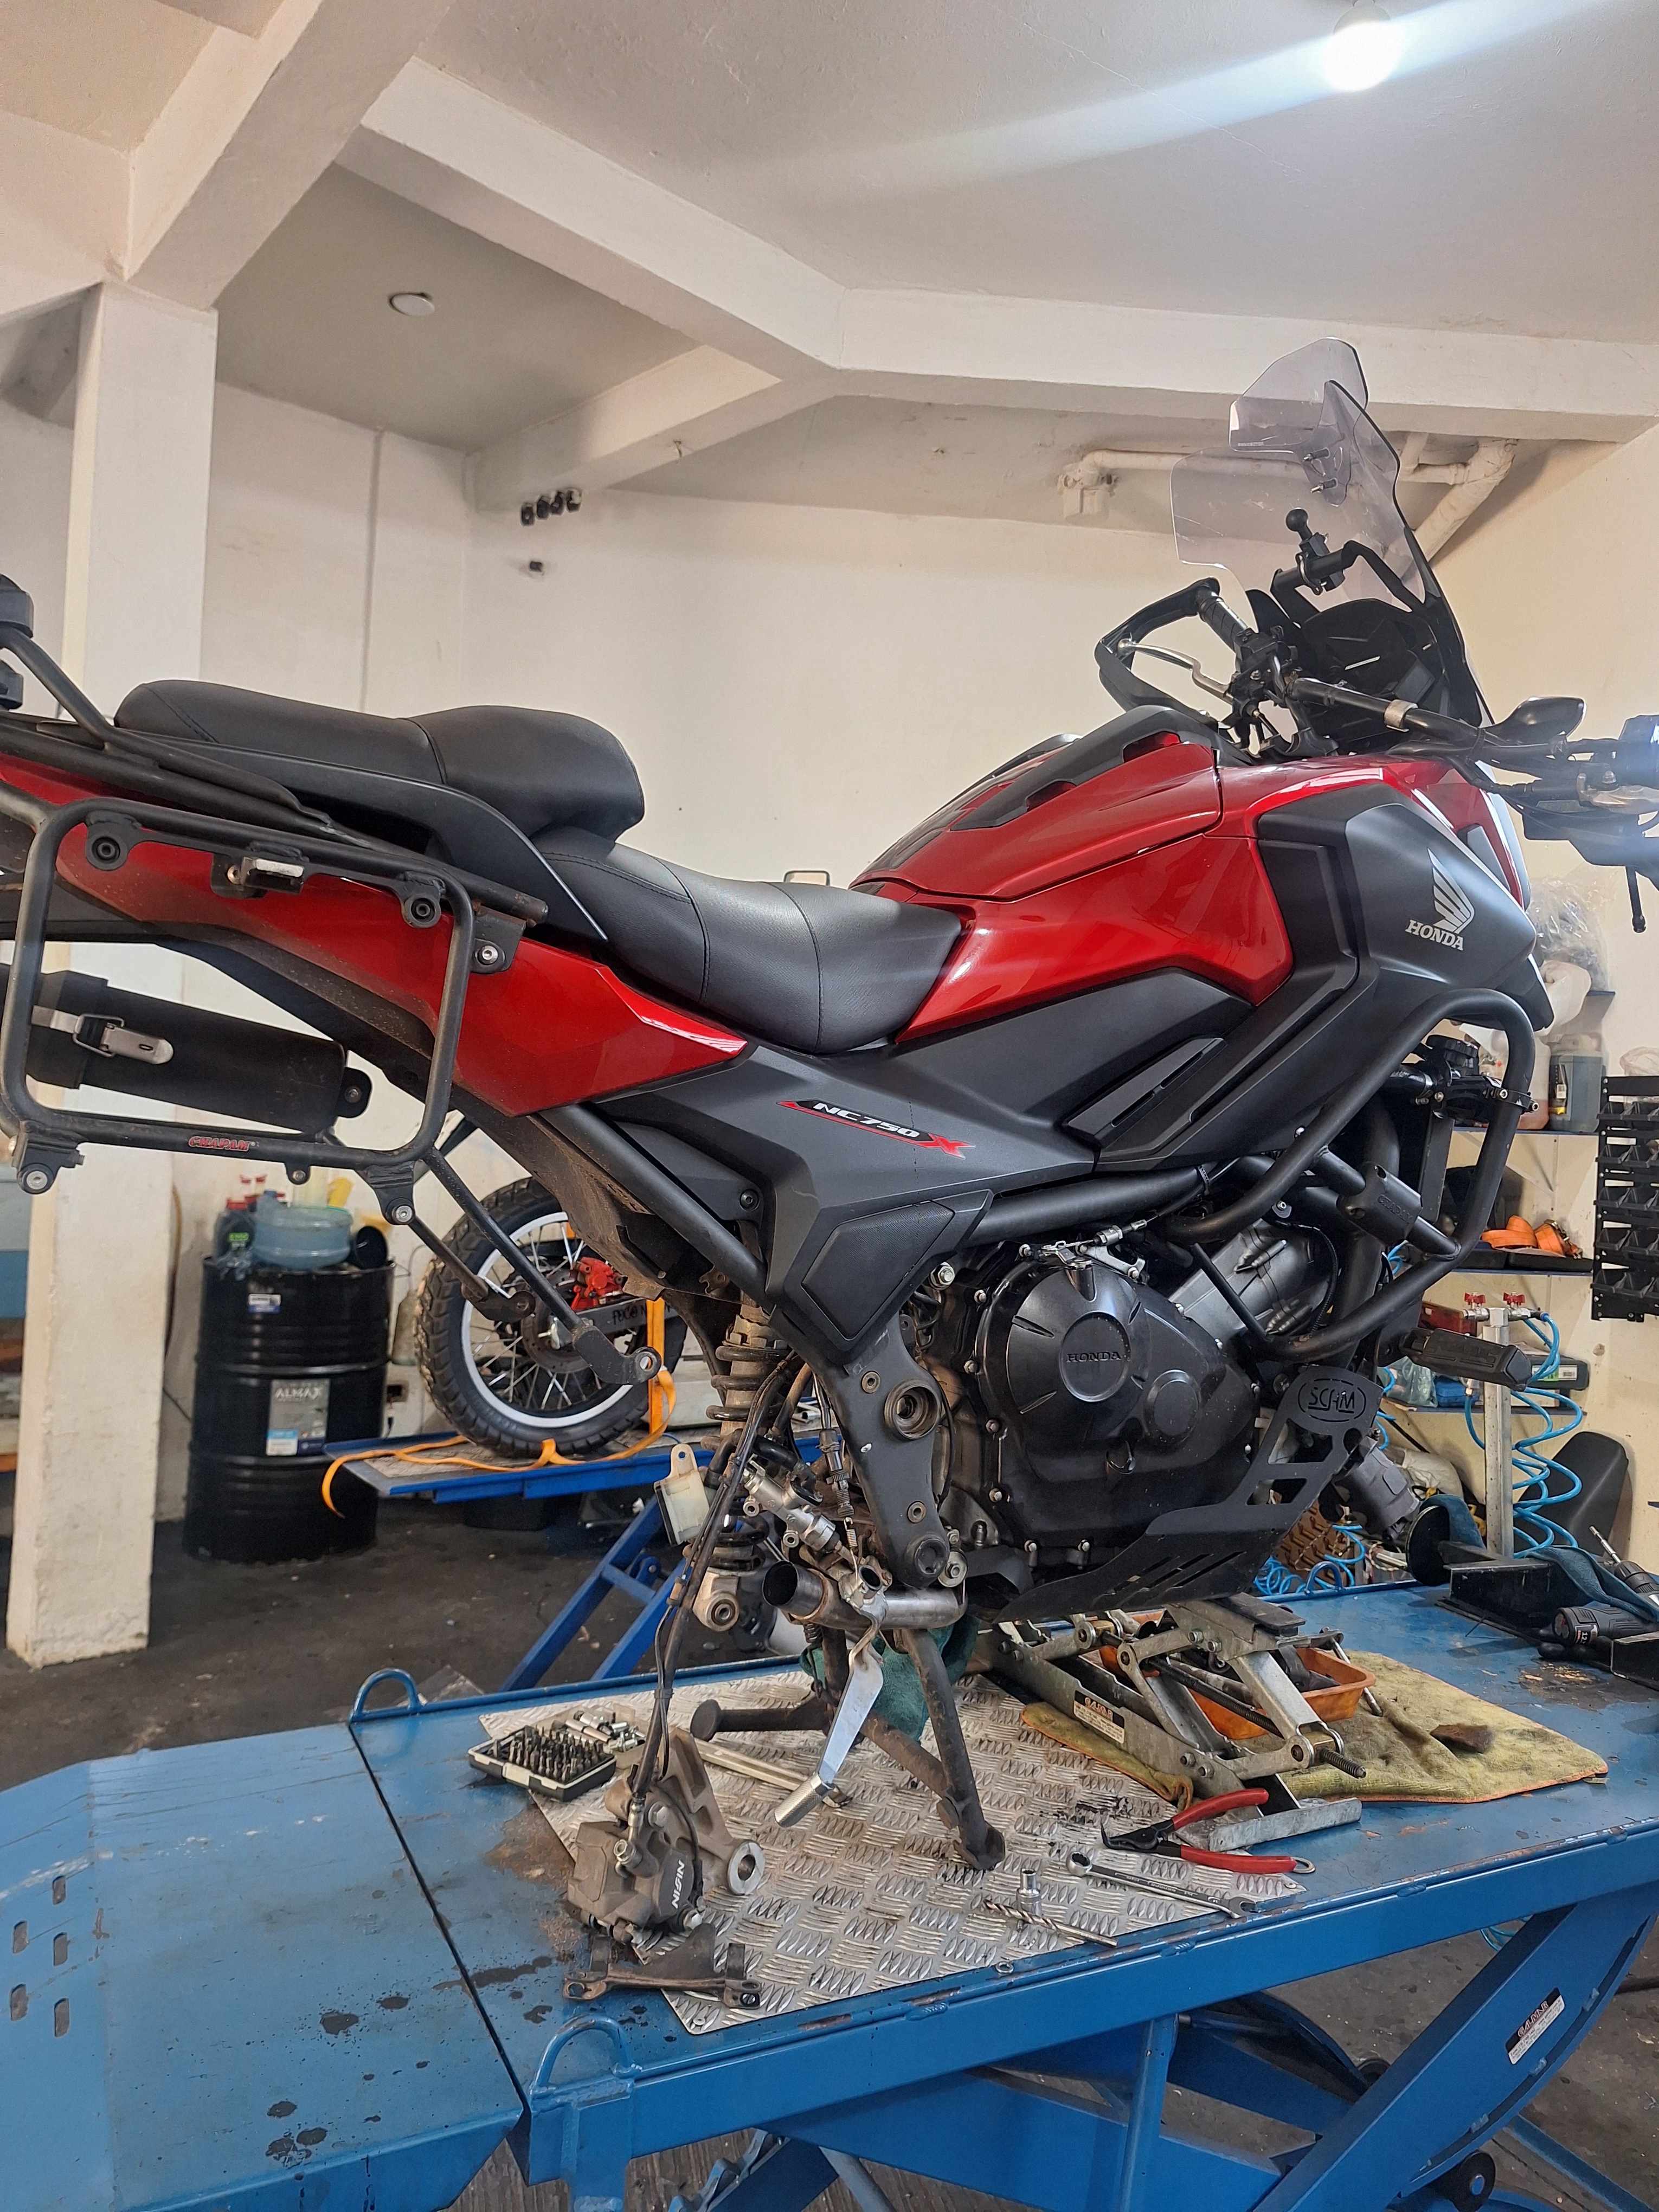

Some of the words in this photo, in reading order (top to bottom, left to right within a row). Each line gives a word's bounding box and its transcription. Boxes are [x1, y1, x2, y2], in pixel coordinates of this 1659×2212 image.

[1405, 919, 1464, 951] HONDA
[188, 1135, 249, 1152] CHAPAM
[1066, 1351, 1123, 1363] HONDA
[671, 1859, 685, 1909] NISSIN
